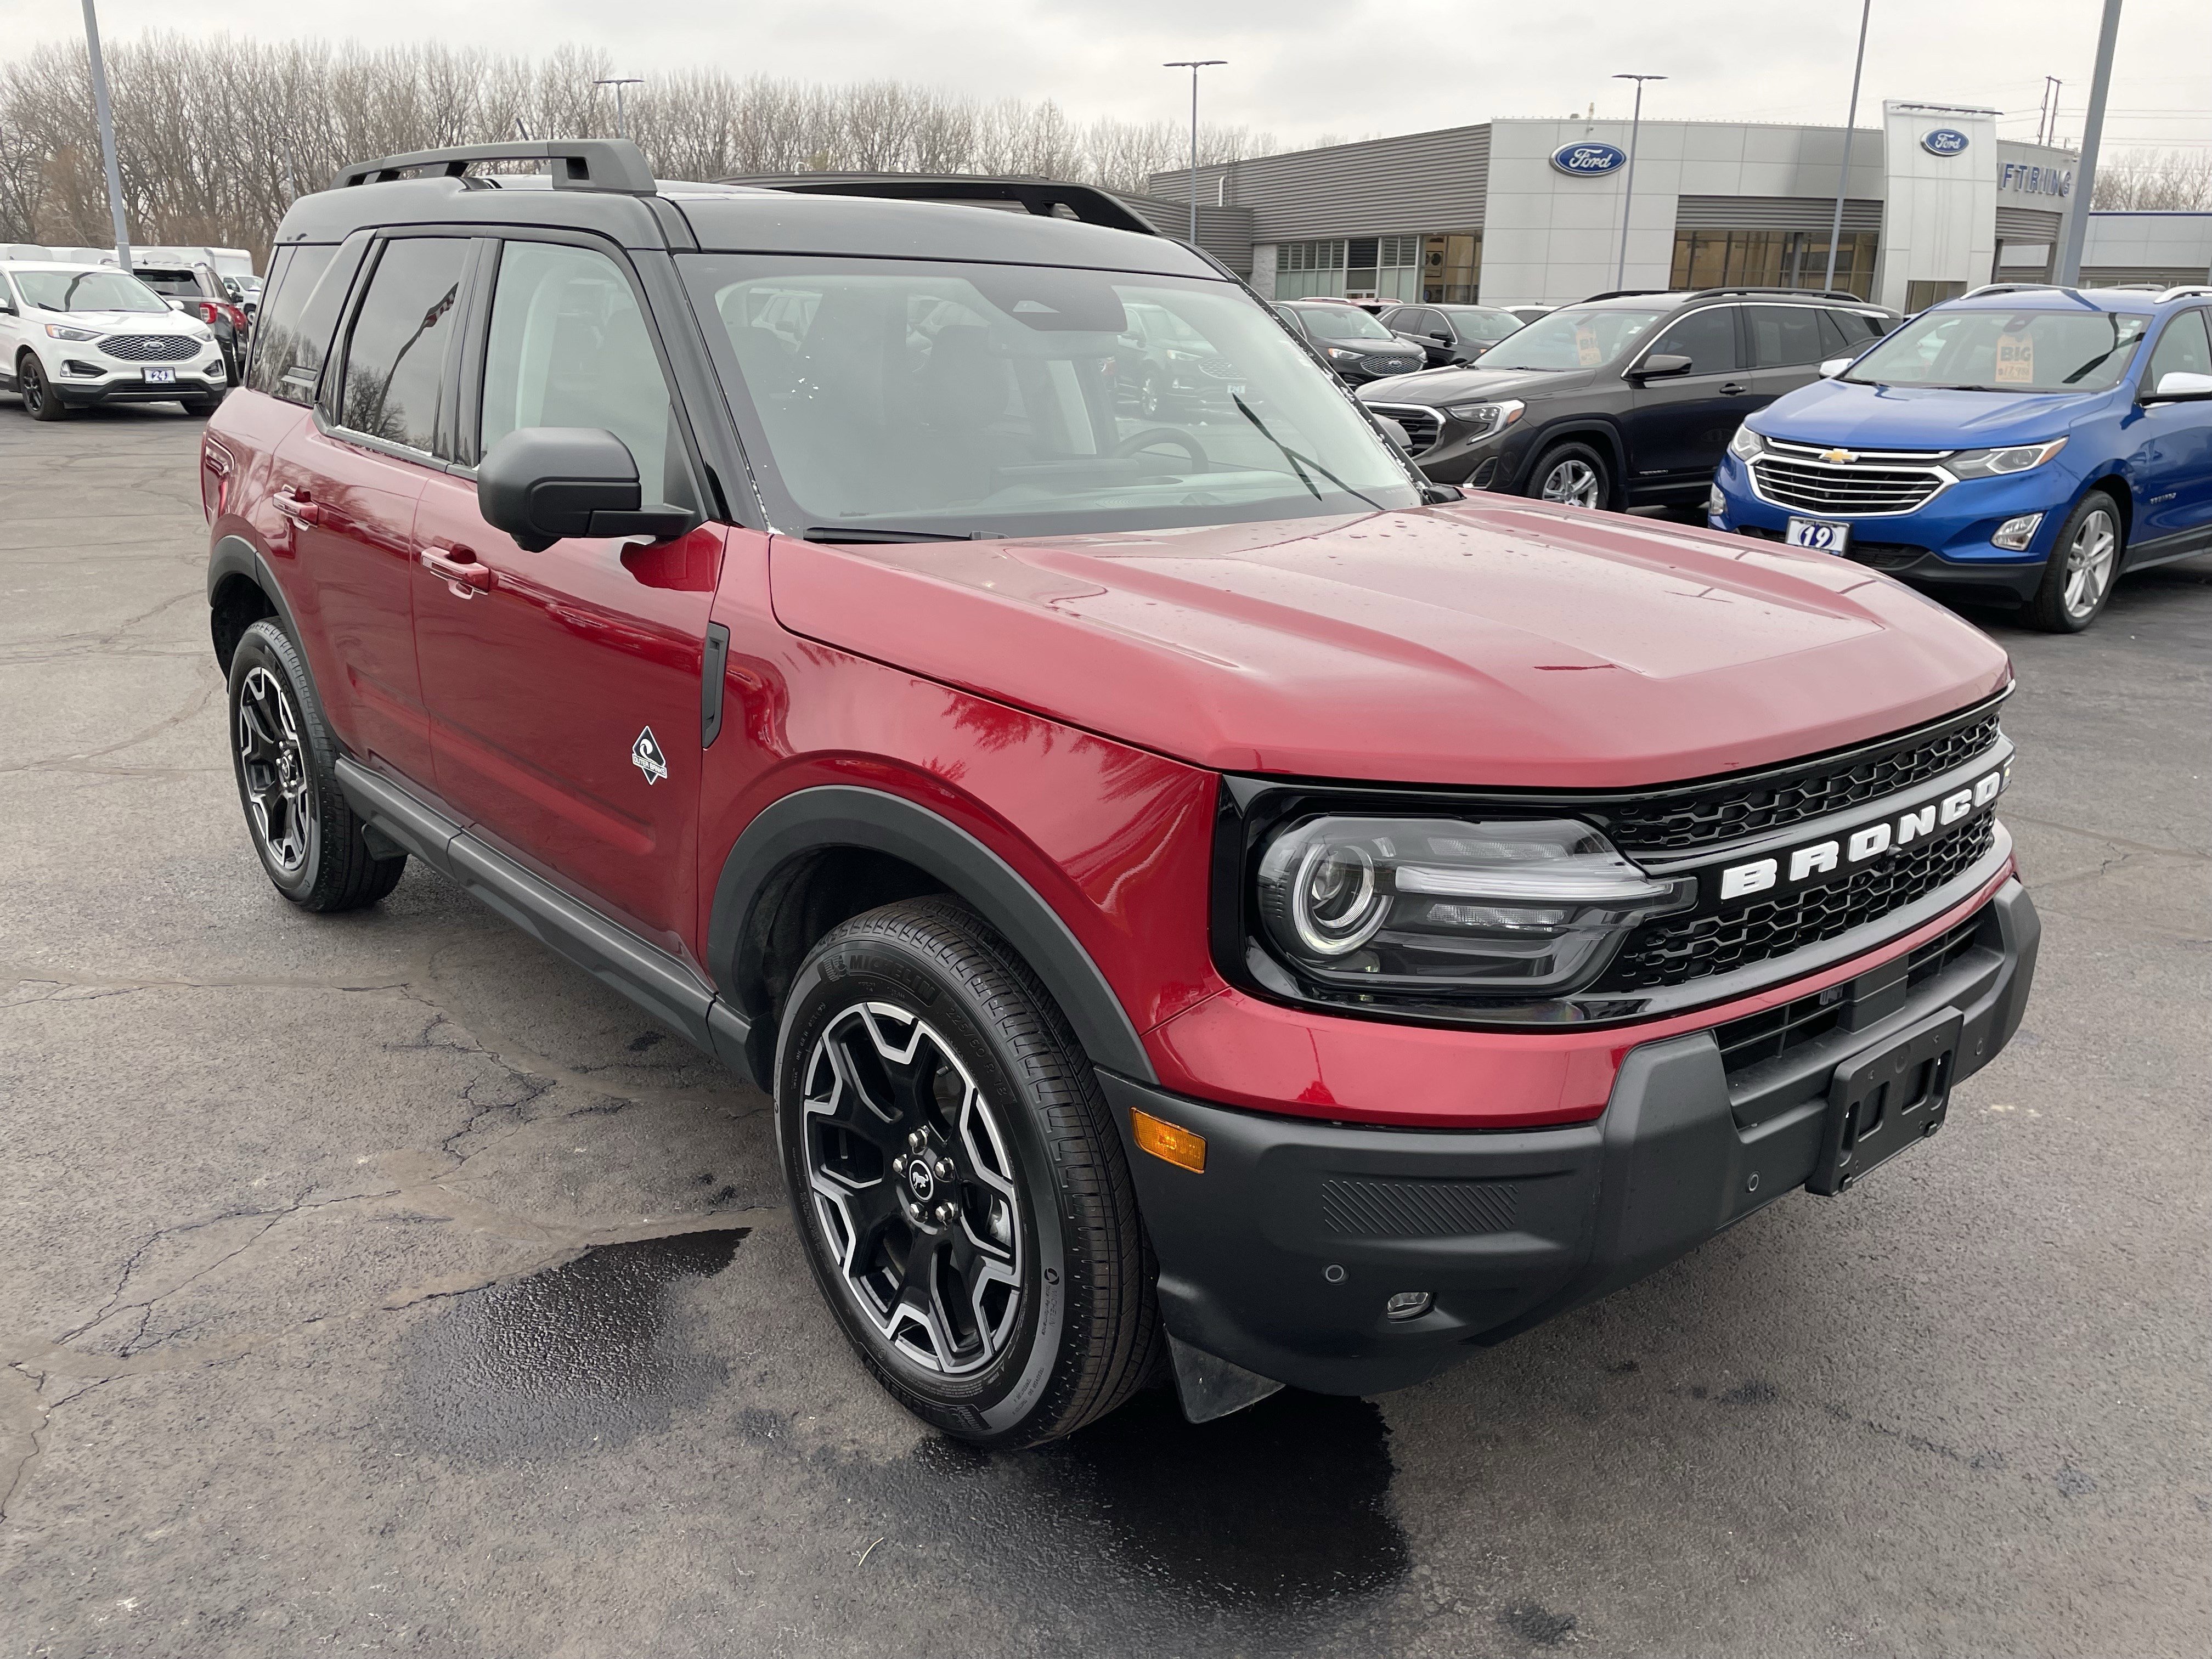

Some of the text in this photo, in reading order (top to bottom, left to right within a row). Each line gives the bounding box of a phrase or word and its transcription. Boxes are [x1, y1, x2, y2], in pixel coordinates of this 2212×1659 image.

[1935, 133, 1961, 149] Ford
[1569, 148, 1613, 168] Ford
[1997, 163, 2072, 197] FTRING
[2000, 346, 2032, 362] BIG
[153, 370, 166, 381] 24
[1803, 525, 1831, 548] 19
[634, 757, 666, 775] OUTER BANKS
[1720, 771, 2000, 900] BRONCO
[849, 954, 935, 1000] MICHELIN
[945, 1007, 986, 1058] 225/60
